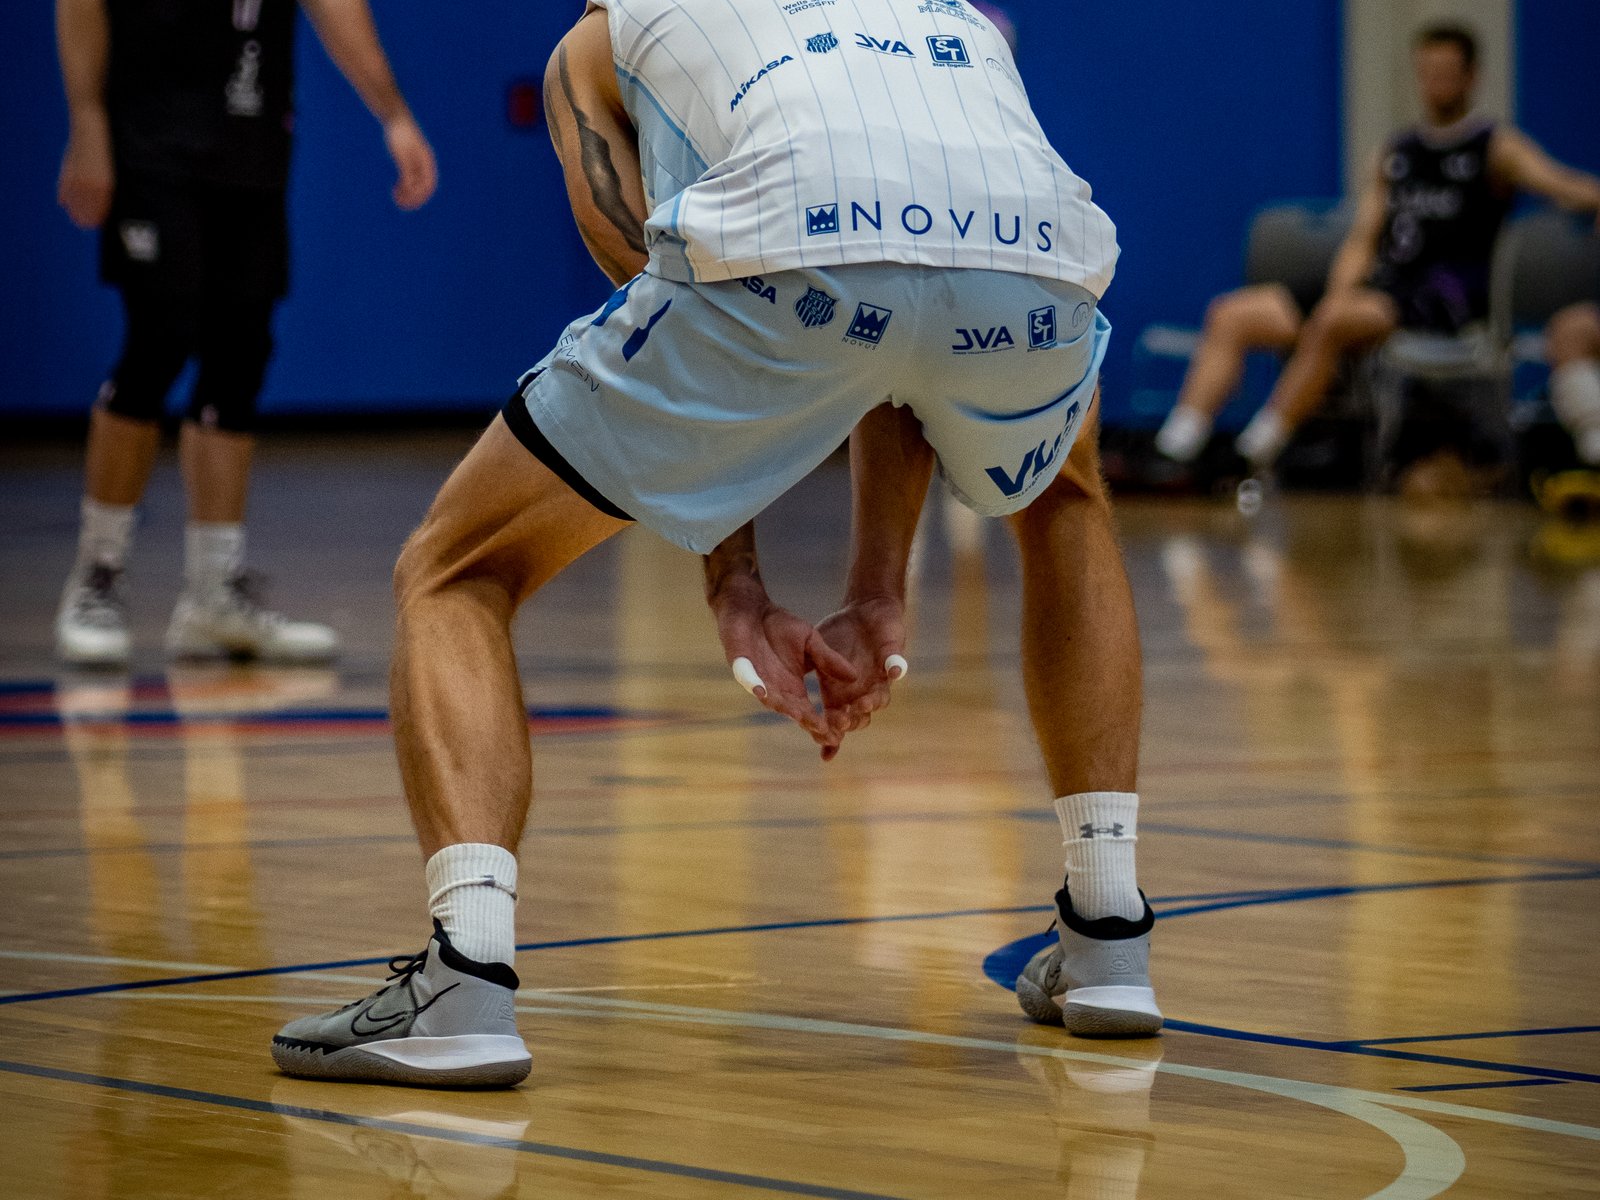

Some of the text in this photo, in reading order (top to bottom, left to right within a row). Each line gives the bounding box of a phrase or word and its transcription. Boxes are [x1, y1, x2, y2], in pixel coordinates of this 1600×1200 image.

[782, 0, 808, 12] Wells
[788, 0, 836, 15] CROSSFIT
[854, 32, 915, 56] JVA
[850, 200, 1053, 253] NOVUS
[841, 337, 879, 351] NOVUS
[952, 326, 1015, 350] JVA
